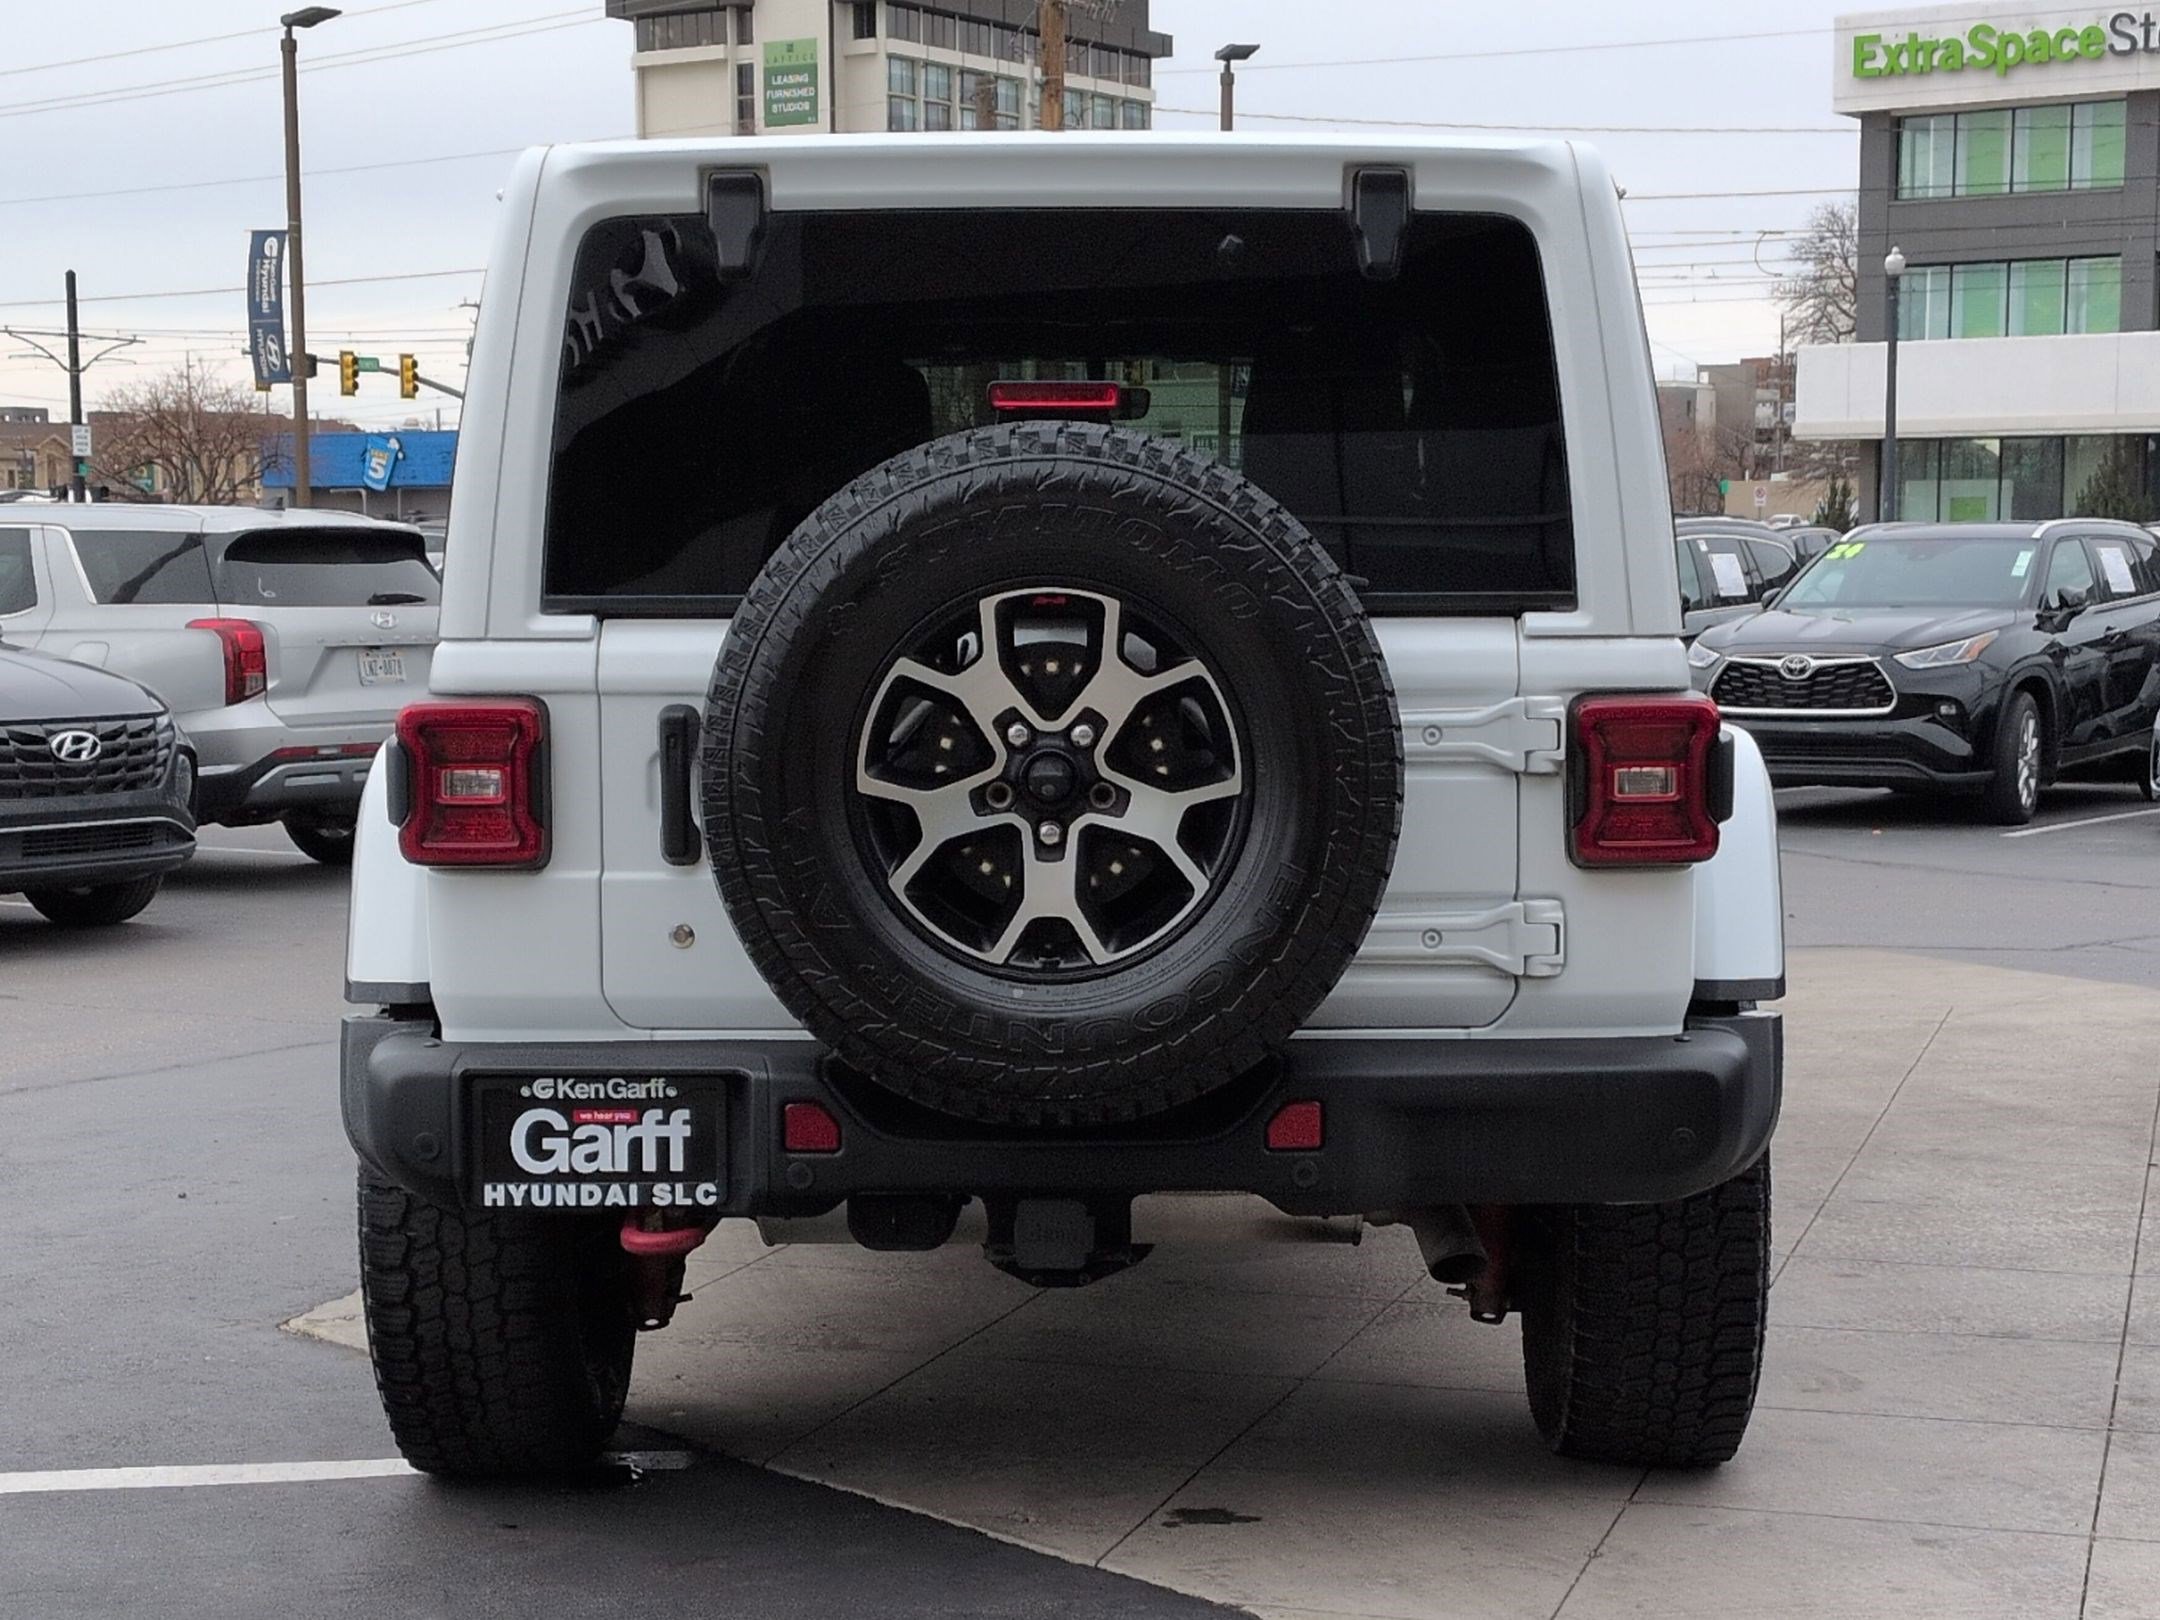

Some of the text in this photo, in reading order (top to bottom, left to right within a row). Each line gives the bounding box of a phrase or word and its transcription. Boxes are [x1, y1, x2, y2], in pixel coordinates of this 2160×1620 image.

[1852, 12, 2160, 79] ExtraSpaceSt
[771, 73, 809, 85] LEASING
[766, 87, 815, 99] FURNISHED
[771, 101, 810, 113] STUDIOS
[261, 259, 271, 314] Hyundai
[557, 1078, 667, 1099] Ken Garff
[579, 1112, 591, 1120] we
[594, 1111, 613, 1120] hear
[510, 1108, 691, 1174] Garff
[484, 1182, 718, 1206] HYUNDAI SLC
